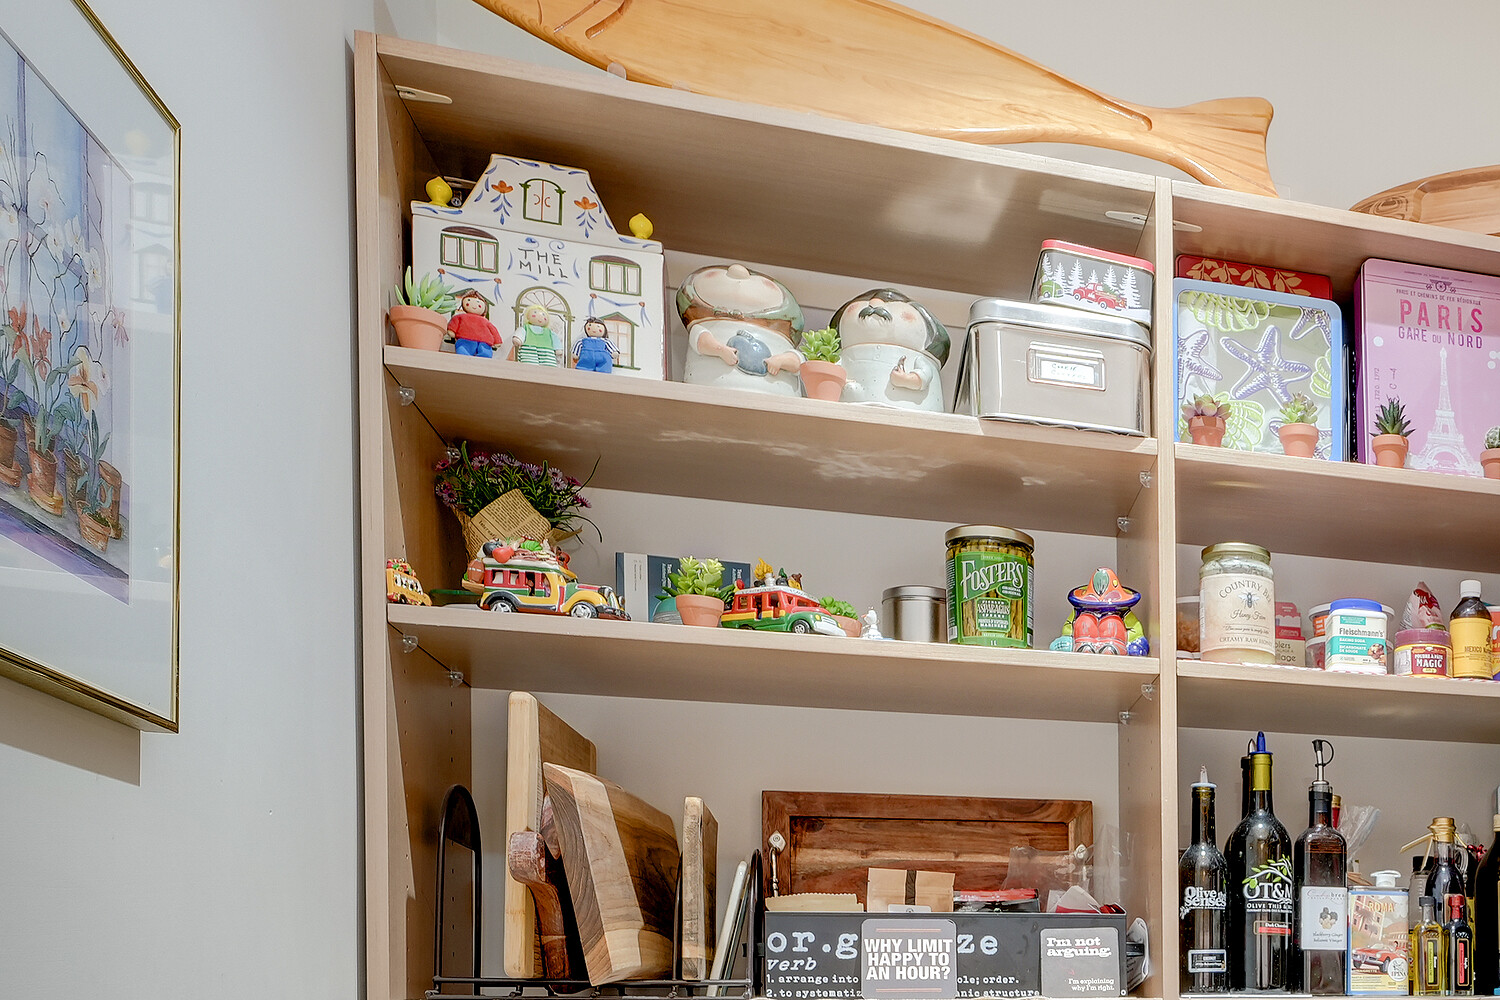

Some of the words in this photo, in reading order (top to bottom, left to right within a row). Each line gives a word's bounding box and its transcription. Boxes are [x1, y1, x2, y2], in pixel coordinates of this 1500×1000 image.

[518, 247, 561, 265] THE
[519, 260, 568, 279] MILL
[1399, 299, 1483, 334] PARIS
[1398, 326, 1428, 343] GARE
[1447, 332, 1483, 349] NORD
[960, 560, 1025, 600] FOSTER'S
[1219, 579, 1262, 599] COUNTRY
[1339, 627, 1384, 638] Fleischmann's
[1416, 659, 1443, 669] MAGIC
[1184, 886, 1217, 899] Olive
[1368, 902, 1395, 912] ROMA
[863, 938, 903, 953] WHY
[907, 938, 954, 953] LIMIT
[1046, 937, 1072, 947] I'm
[1074, 936, 1101, 947] not
[867, 952, 925, 966] HAPPY
[928, 952, 951, 966] TO
[1046, 947, 1112, 958] arguing.
[767, 956, 818, 971] verb
[778, 975, 829, 985] arrange
[831, 974, 859, 984] into
[982, 975, 1020, 984] order.
[865, 965, 890, 981] AN
[895, 965, 951, 981] HOUR?
[1079, 977, 1115, 986] explaining
[766, 988, 778, 998] 2.
[779, 988, 792, 998] to
